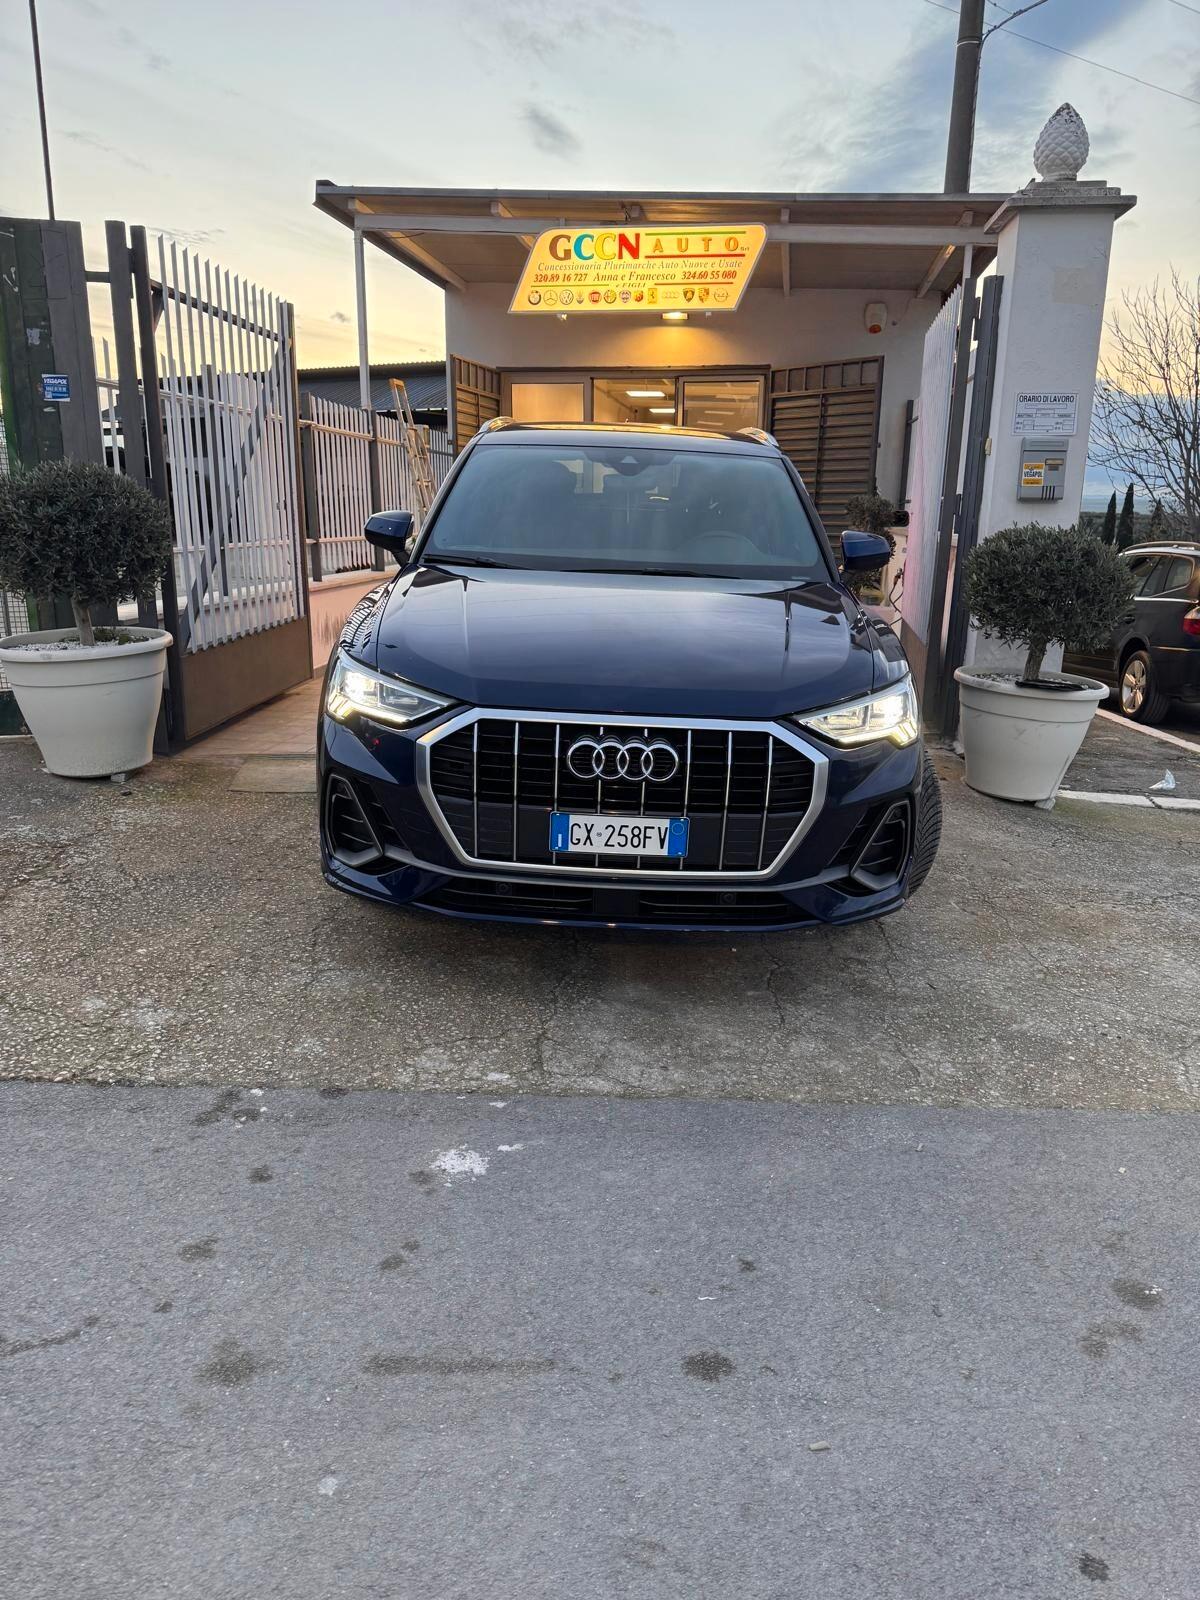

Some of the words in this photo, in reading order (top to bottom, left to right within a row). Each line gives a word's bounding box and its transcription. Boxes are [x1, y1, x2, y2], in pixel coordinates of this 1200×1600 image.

[549, 233, 640, 261] GCCN
[653, 237, 739, 253] AUTO
[538, 262, 601, 271] Concessionaria
[603, 261, 656, 270] Plurimarche
[658, 260, 679, 269] Auto
[681, 260, 709, 268] Nuove
[718, 259, 743, 268] Usate
[534, 273, 560, 283] 320.89
[562, 273, 571, 282] 16
[573, 273, 588, 282] 727
[593, 272, 618, 281] Anna
[628, 271, 676, 281] Francesco
[681, 271, 709, 280] 324.60
[710, 271, 720, 280] 55
[721, 270, 737, 280] 080
[1019, 395, 1042, 403] ORARIO
[1043, 395, 1049, 403] DI
[1050, 395, 1075, 403] LAVORO
[570, 823, 595, 846] GX
[604, 824, 669, 850] 258FV
